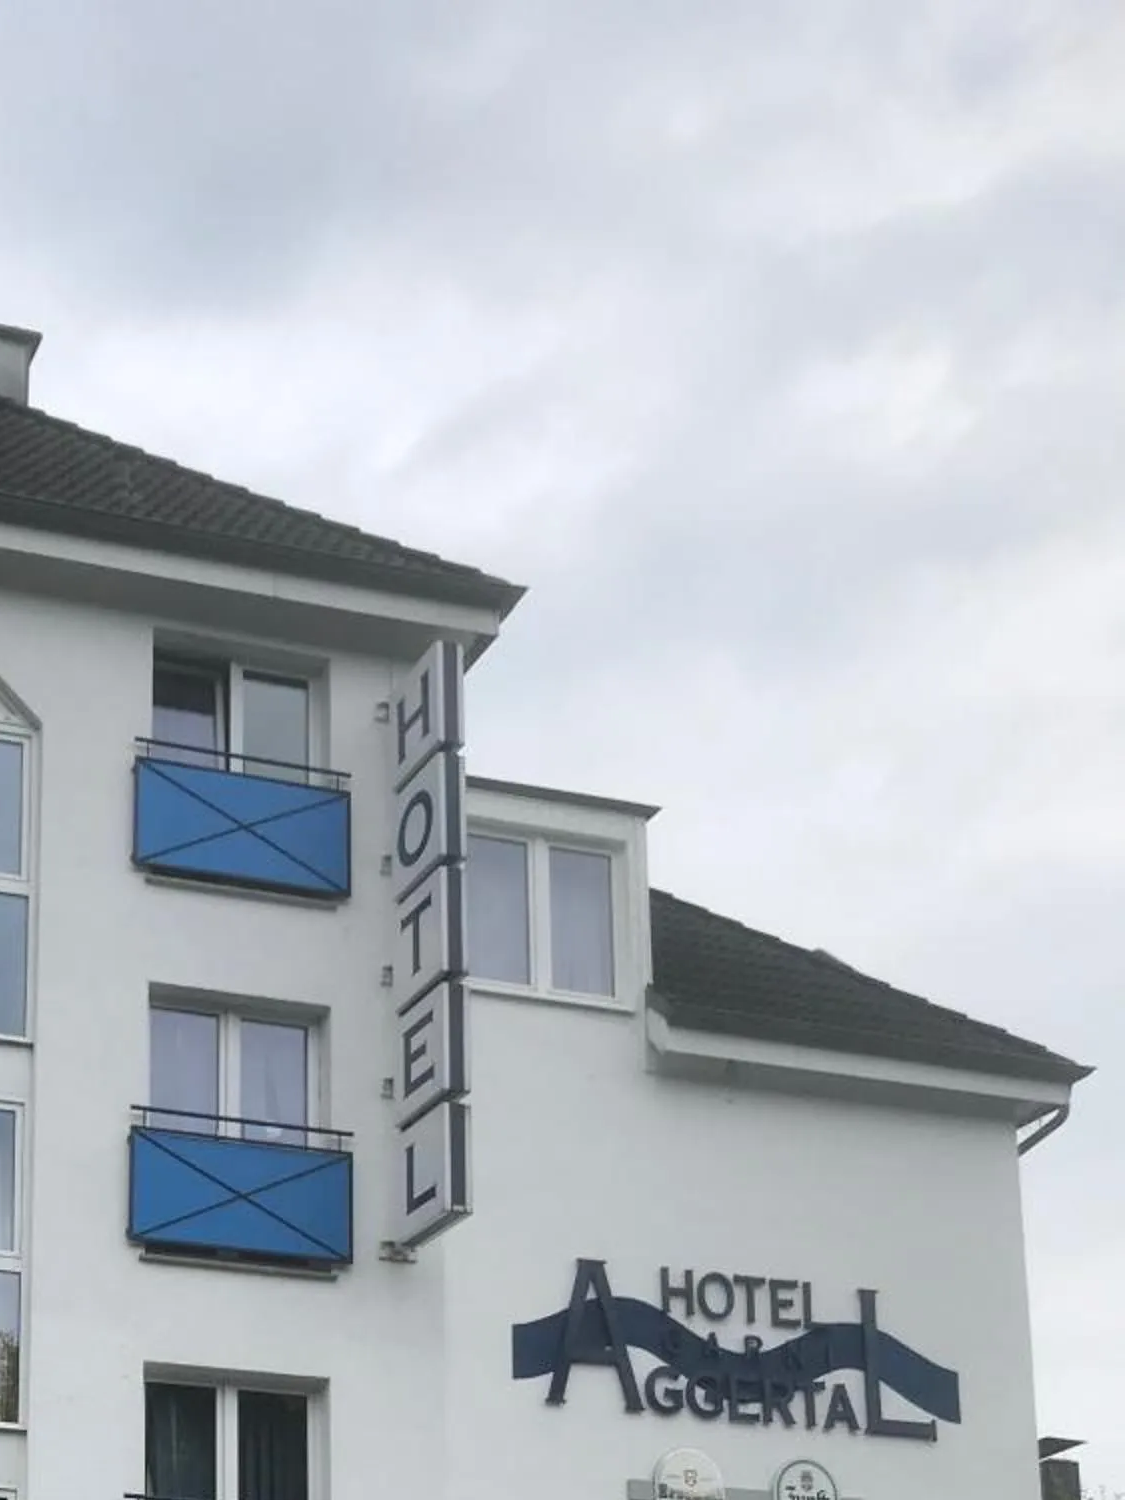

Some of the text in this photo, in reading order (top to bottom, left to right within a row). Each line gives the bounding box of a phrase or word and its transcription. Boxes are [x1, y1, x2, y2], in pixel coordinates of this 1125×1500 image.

[396, 669, 437, 1216] HOTEL
[545, 1258, 938, 1443] AGGERTAL
[659, 1266, 816, 1330] HOTEL
